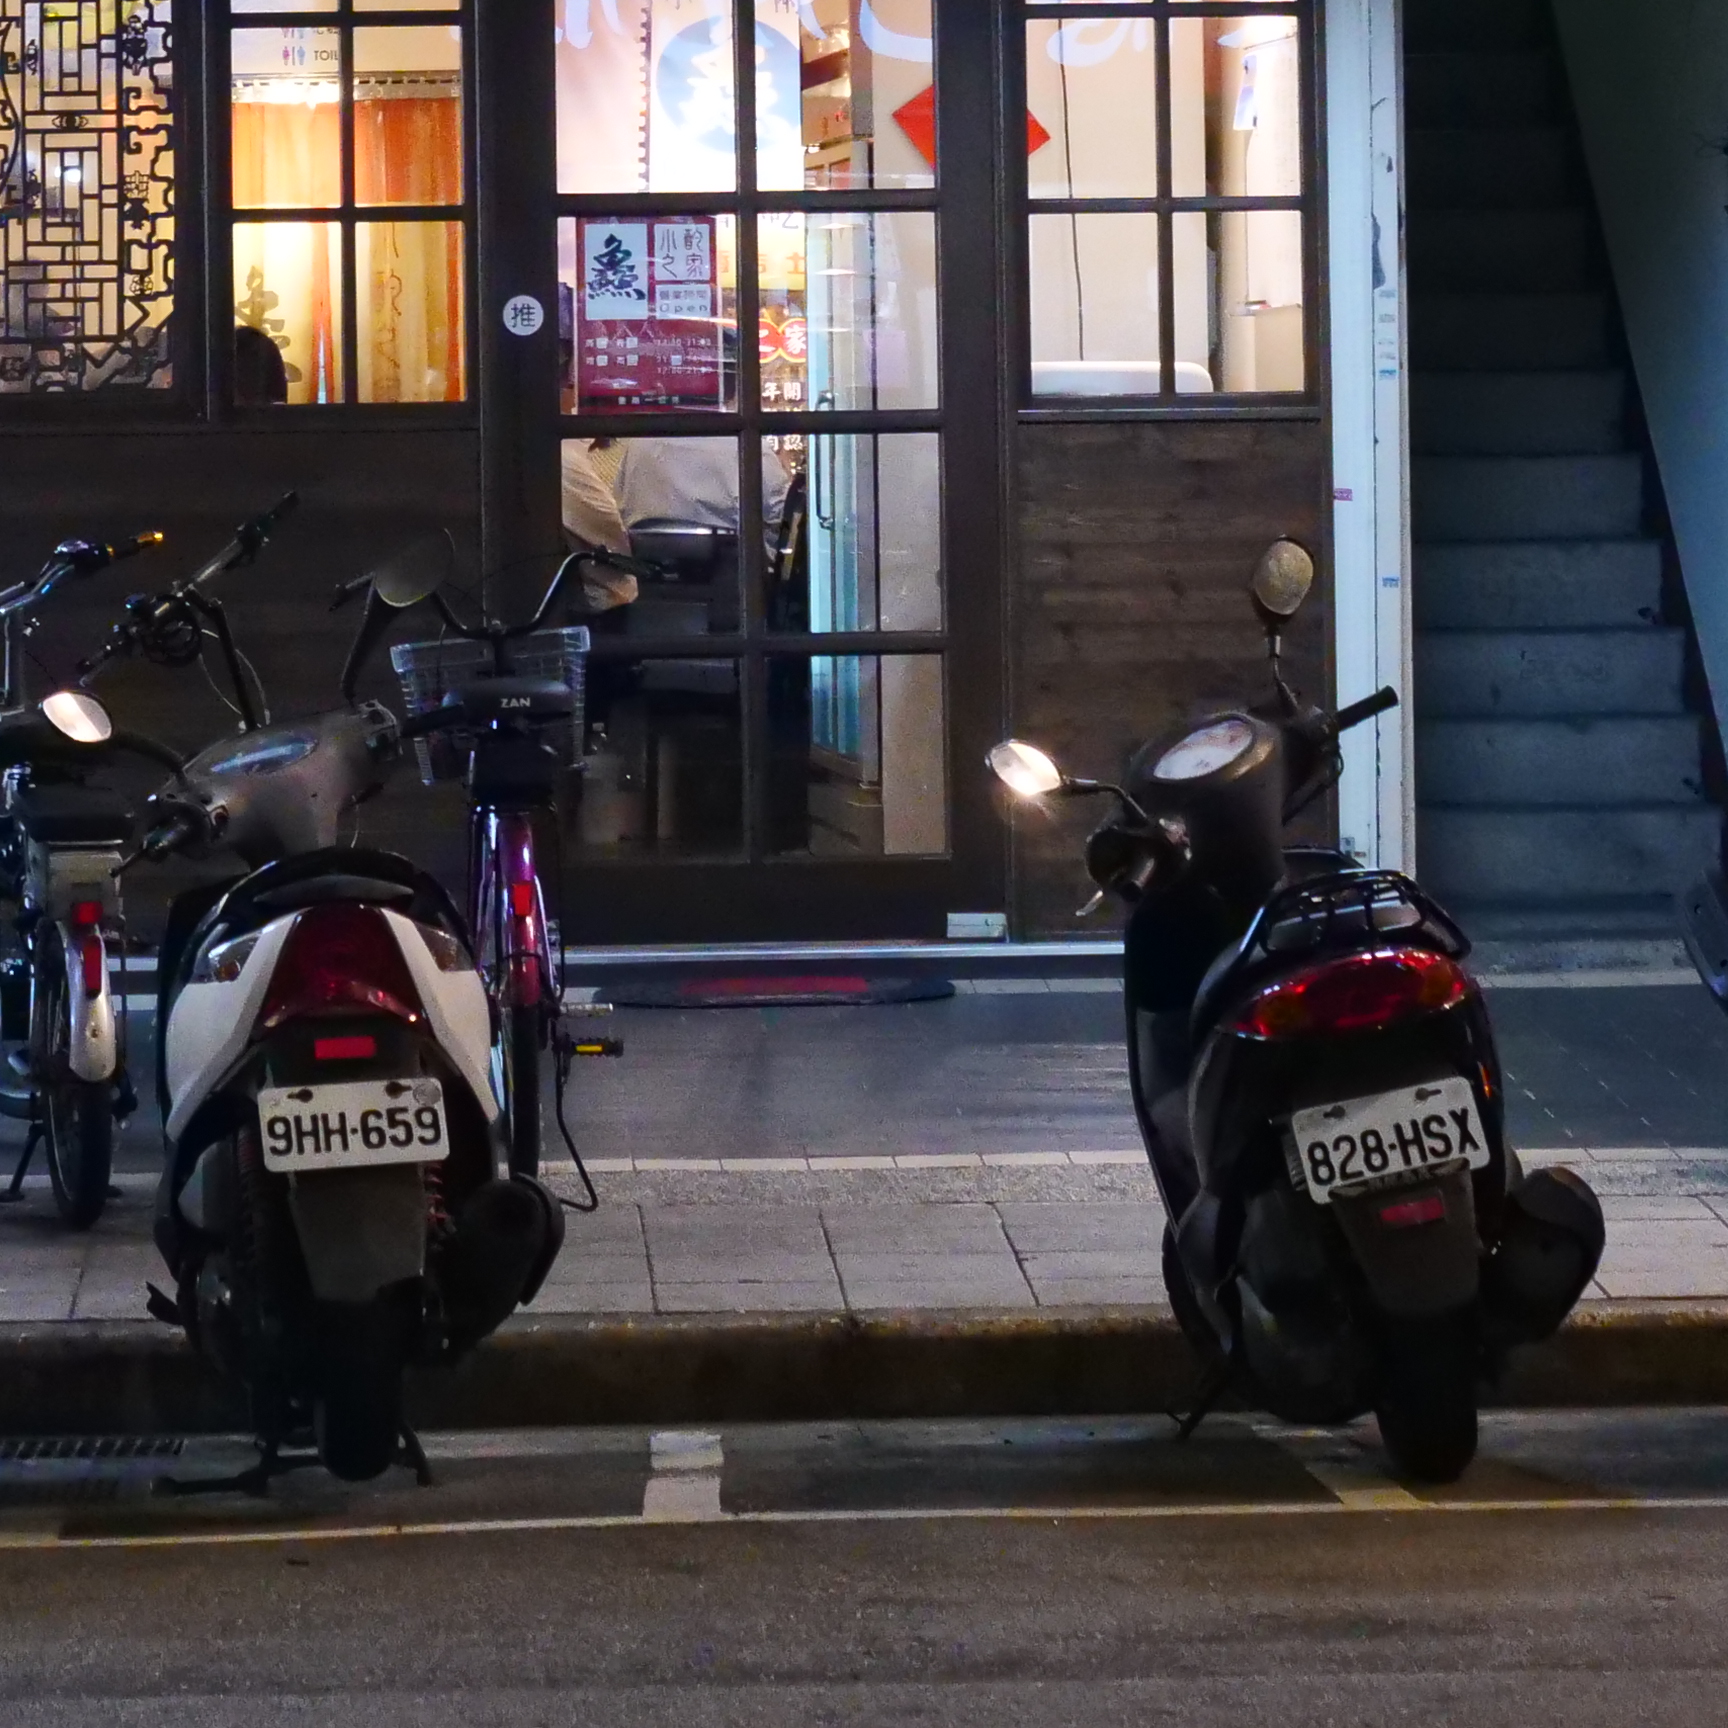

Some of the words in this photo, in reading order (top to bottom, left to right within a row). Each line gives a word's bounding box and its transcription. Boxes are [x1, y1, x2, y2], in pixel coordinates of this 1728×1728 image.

[659, 303, 708, 314] Open
[511, 303, 536, 328] 推
[500, 696, 531, 709] ZAN
